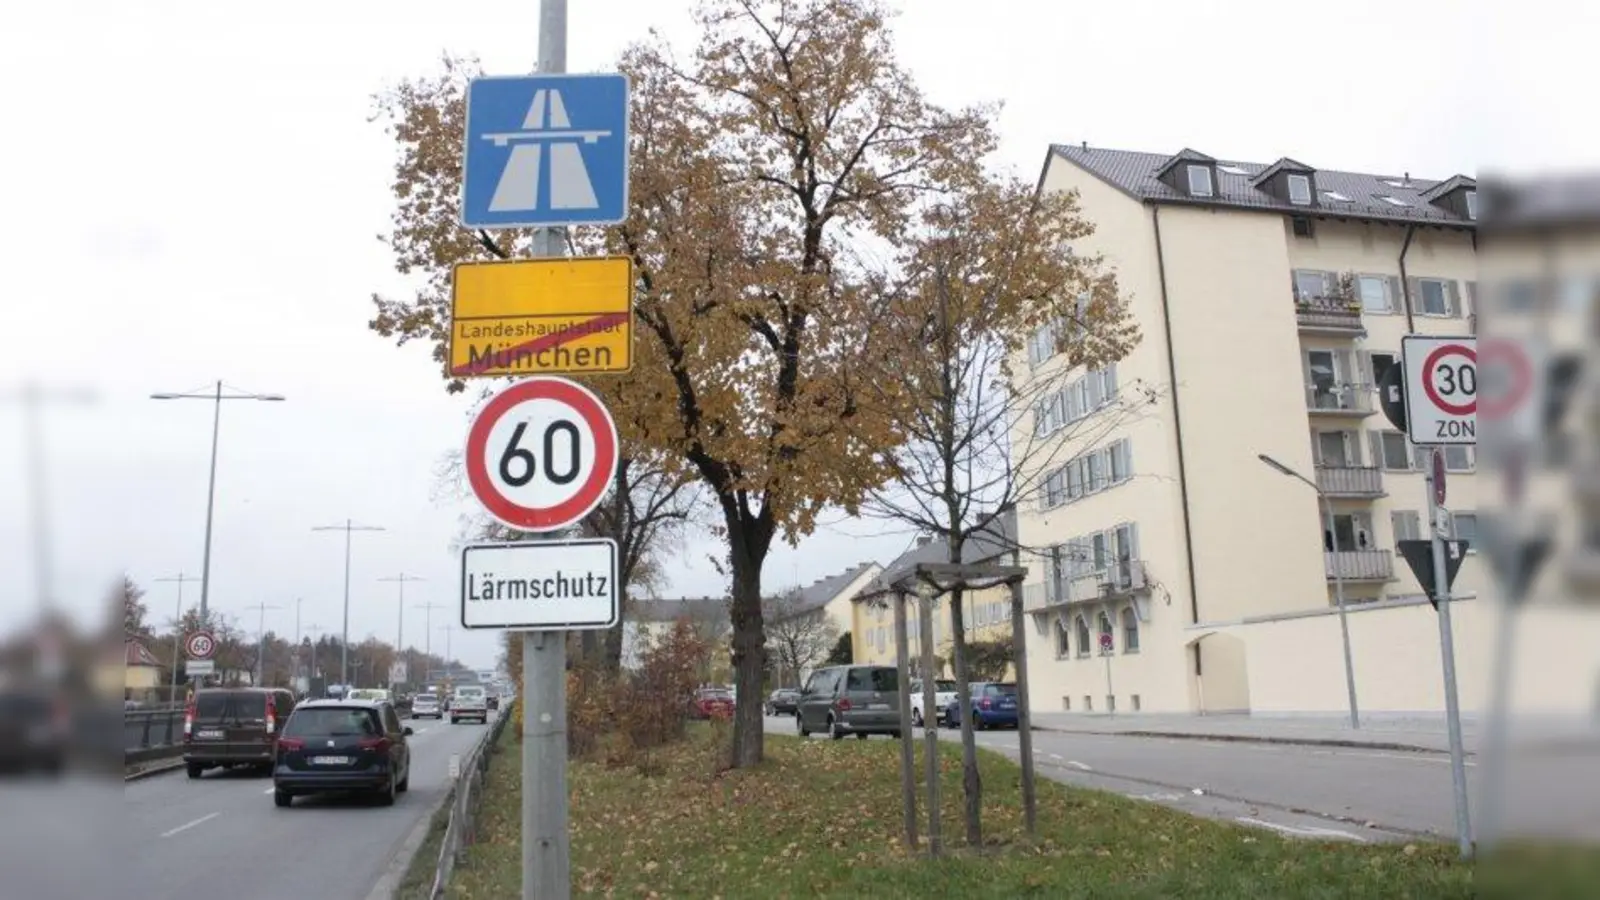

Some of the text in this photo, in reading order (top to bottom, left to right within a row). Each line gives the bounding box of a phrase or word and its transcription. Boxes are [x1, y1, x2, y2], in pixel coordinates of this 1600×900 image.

[468, 342, 612, 370] München
[1437, 364, 1476, 396] 30
[499, 419, 581, 487] 60
[468, 570, 608, 601] Lärmschutz
[193, 638, 210, 651] 60
